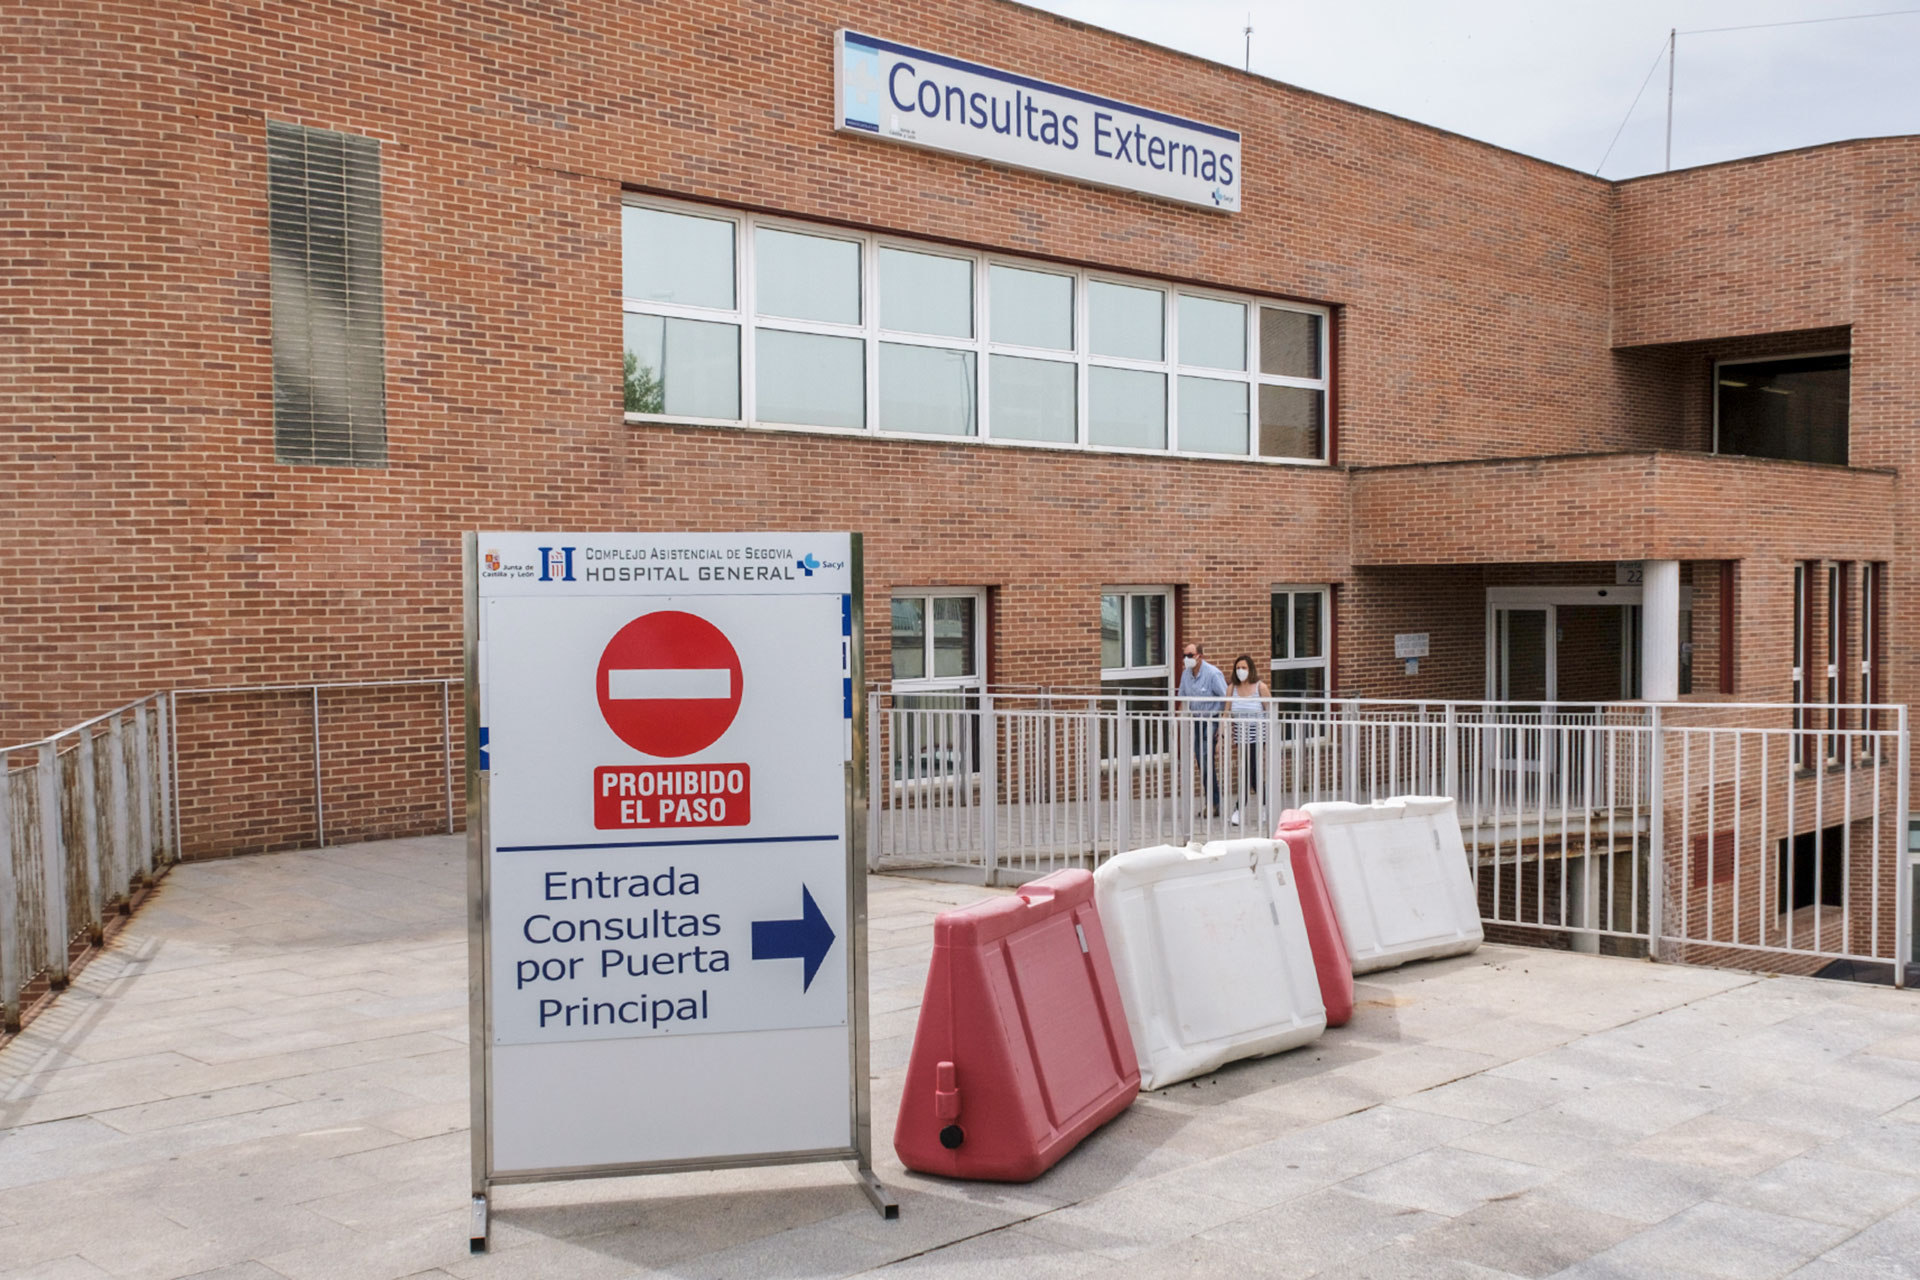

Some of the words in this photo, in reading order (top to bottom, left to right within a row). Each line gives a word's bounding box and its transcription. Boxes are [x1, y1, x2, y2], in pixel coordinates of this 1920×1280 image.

[888, 62, 1079, 150] Consultas
[1093, 111, 1234, 186] Externas
[586, 547, 647, 561] COMPLEJO
[650, 547, 723, 561] ASISTENCIAL
[726, 548, 741, 560] DE
[745, 546, 793, 560] SEGOVIA
[822, 560, 845, 571] Sacyl
[482, 570, 508, 578] Castilla
[517, 569, 535, 578] León
[586, 566, 690, 582] HOSPITAL
[698, 565, 795, 581] GENERAL
[1627, 570, 1643, 583] 22
[602, 769, 744, 797] PROHIBIDO
[620, 800, 651, 824] EL
[659, 797, 726, 823] PASO
[545, 866, 700, 901] Entrada
[523, 908, 721, 944] Consultas
[517, 957, 584, 990] por
[601, 945, 730, 978] Puerta
[539, 989, 708, 1029] Principal
